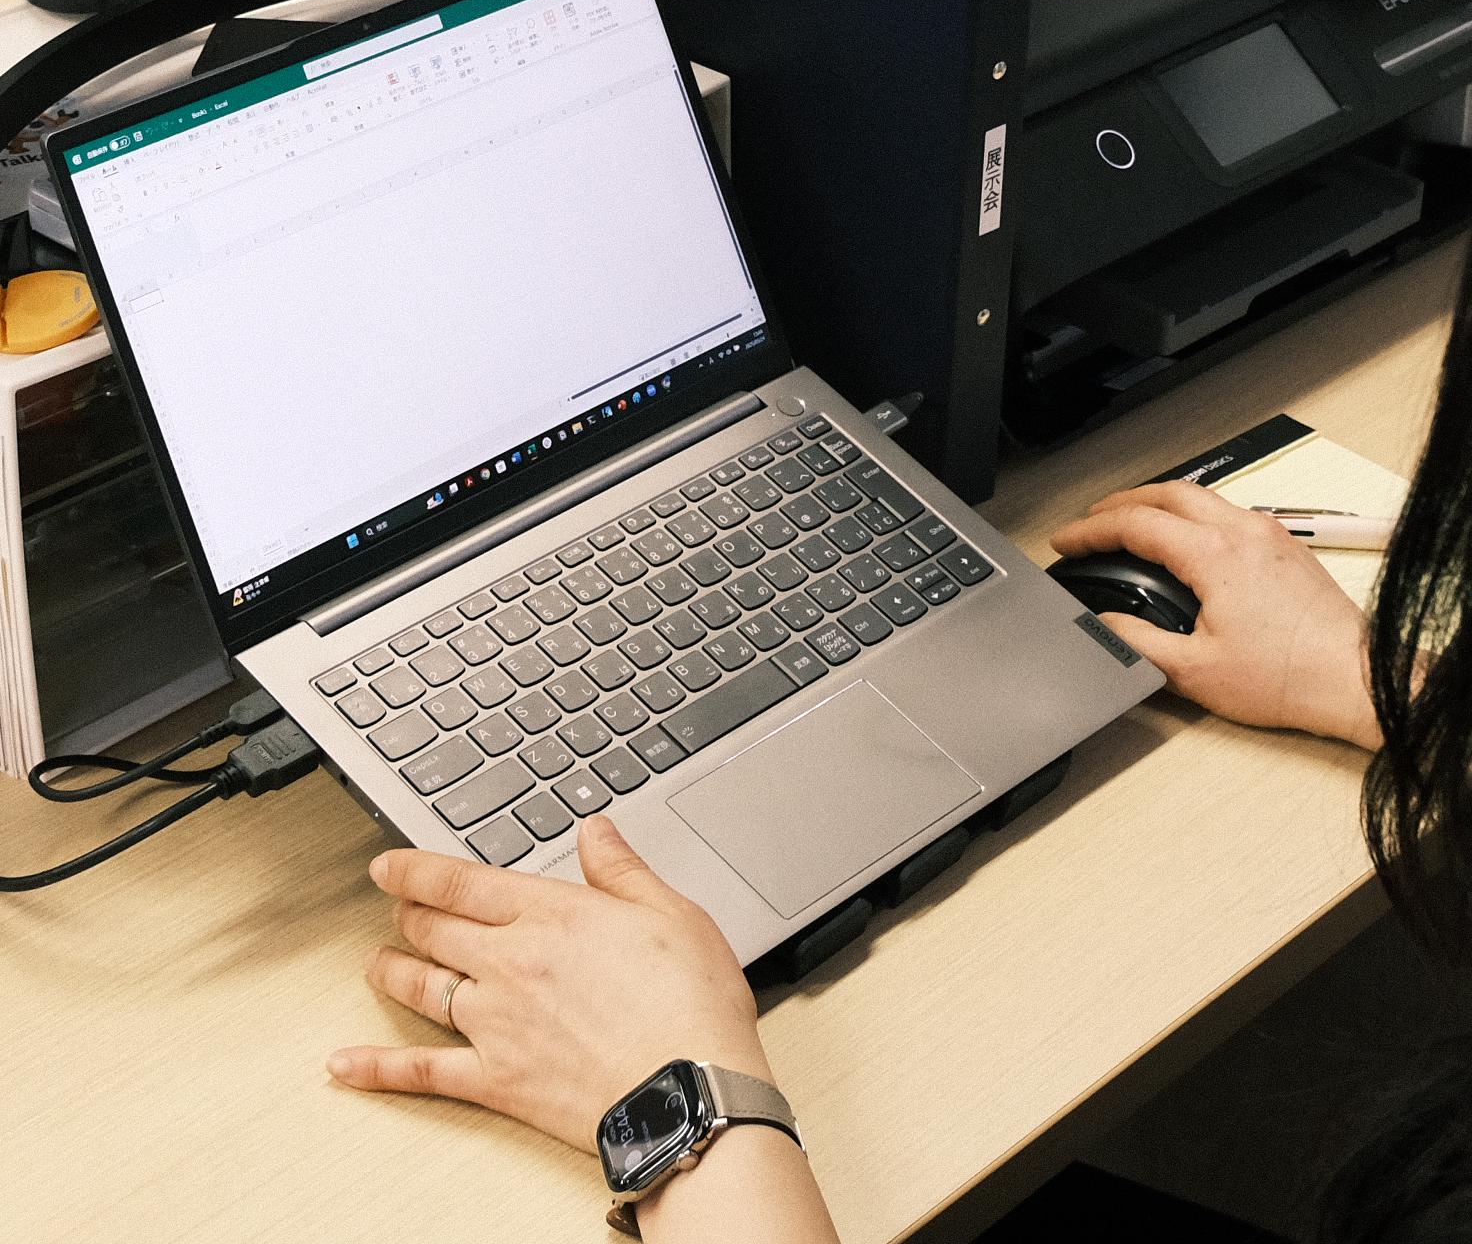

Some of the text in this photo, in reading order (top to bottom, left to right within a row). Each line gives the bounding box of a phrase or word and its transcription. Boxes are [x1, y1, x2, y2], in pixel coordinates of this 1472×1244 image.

[214, 100, 229, 111] Excel
[983, 146, 1002, 214] 展示会
[1207, 454, 1234, 471] basics
[861, 467, 880, 478] Enter
[753, 524, 764, 534] P
[684, 534, 694, 542] 9
[722, 542, 735, 552] O
[650, 552, 660, 561] 8
[614, 571, 623, 579] 7
[764, 568, 777, 577] L
[654, 579, 666, 590] U
[731, 583, 744, 595] K
[580, 590, 590, 598] 6
[617, 598, 629, 608] Y
[542, 609, 553, 619] 5
[698, 604, 709, 614] J
[581, 618, 593, 629] T
[660, 623, 675, 634] H
[855, 621, 869, 632] Ctrl
[505, 630, 515, 639] 4
[745, 624, 760, 636] M
[1084, 617, 1134, 661] Lenovo
[544, 640, 559, 652] R
[627, 643, 640, 654] G
[711, 644, 725, 655] N
[468, 651, 478, 661] 3
[506, 660, 520, 671] E
[589, 663, 599, 675] F
[675, 664, 689, 676] B
[429, 672, 439, 681] 2
[552, 685, 566, 696] D
[640, 684, 652, 696] V
[515, 707, 528, 718] S
[604, 707, 616, 718] C
[478, 729, 491, 740] A
[565, 728, 580, 740] X
[526, 750, 540, 763] Z
[617, 1106, 635, 1149] 13:44
